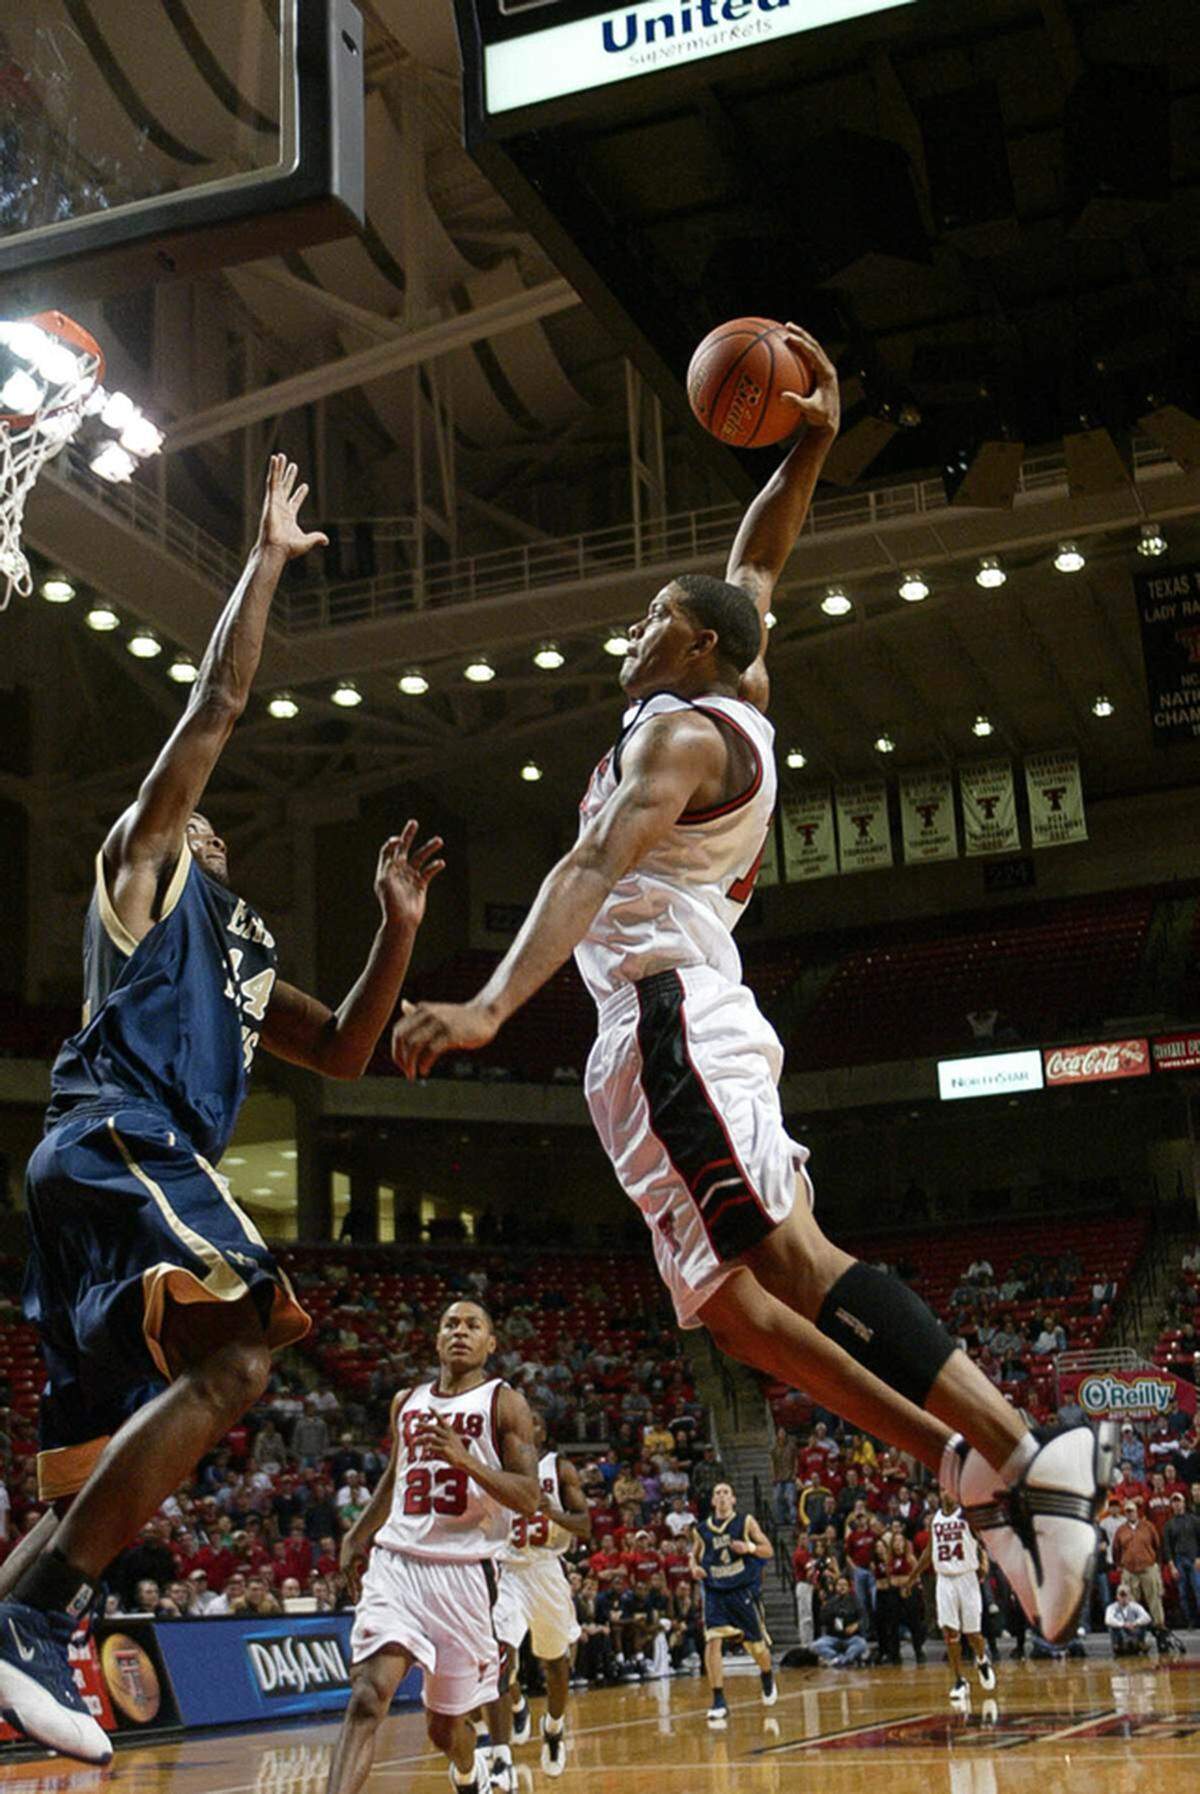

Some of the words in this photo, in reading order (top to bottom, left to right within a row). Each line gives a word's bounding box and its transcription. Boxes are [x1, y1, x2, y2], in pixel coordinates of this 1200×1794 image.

[602, 0, 790, 53] United
[1148, 574, 1190, 600] TEXAS
[1144, 604, 1176, 623] LADY
[1084, 1379, 1168, 1408] O'Reilly
[404, 1468, 468, 1516] 23
[938, 1543, 964, 1561] 24
[250, 1637, 348, 1693] DASANI
